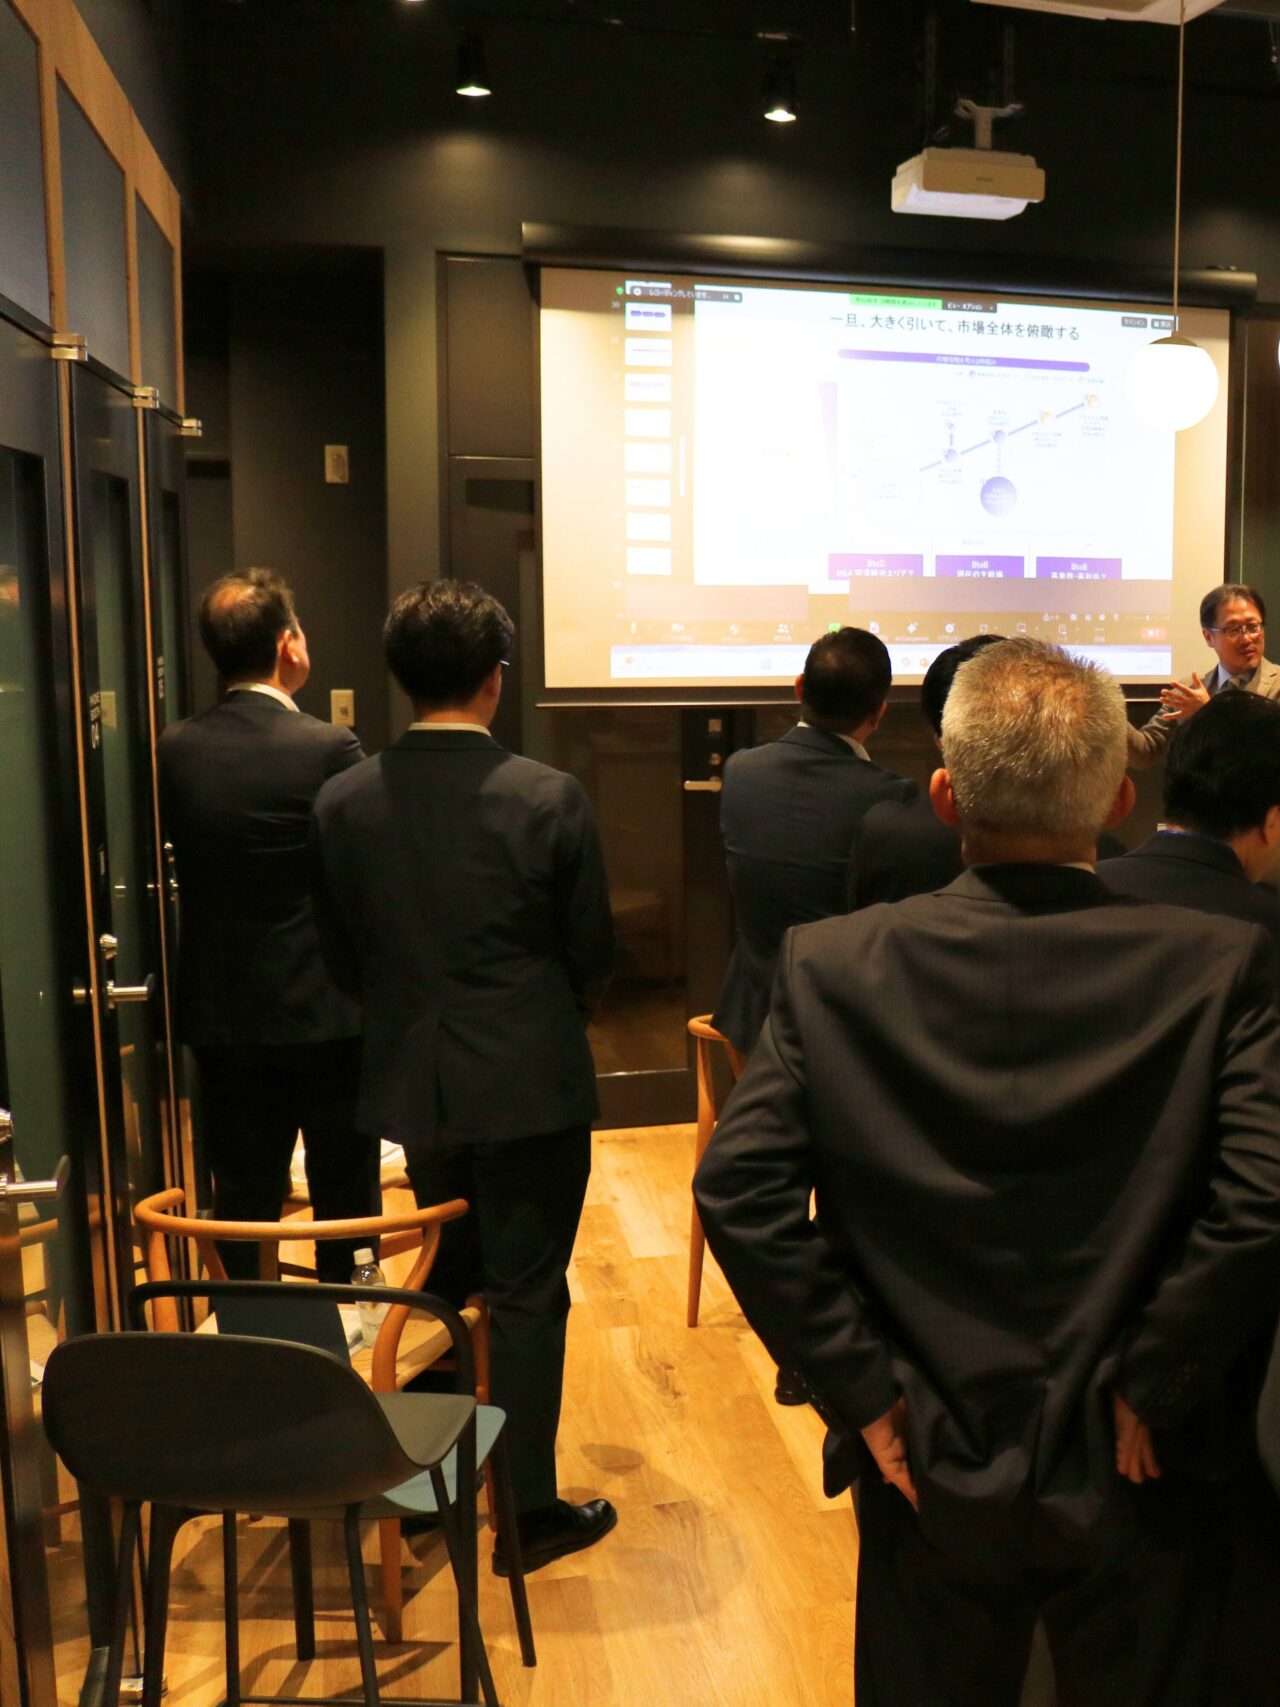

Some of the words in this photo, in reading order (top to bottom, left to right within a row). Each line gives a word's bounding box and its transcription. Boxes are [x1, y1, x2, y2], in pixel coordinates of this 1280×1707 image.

[830, 311, 1080, 341] 一旦、大きく引いて、市場全体を俯瞰する
